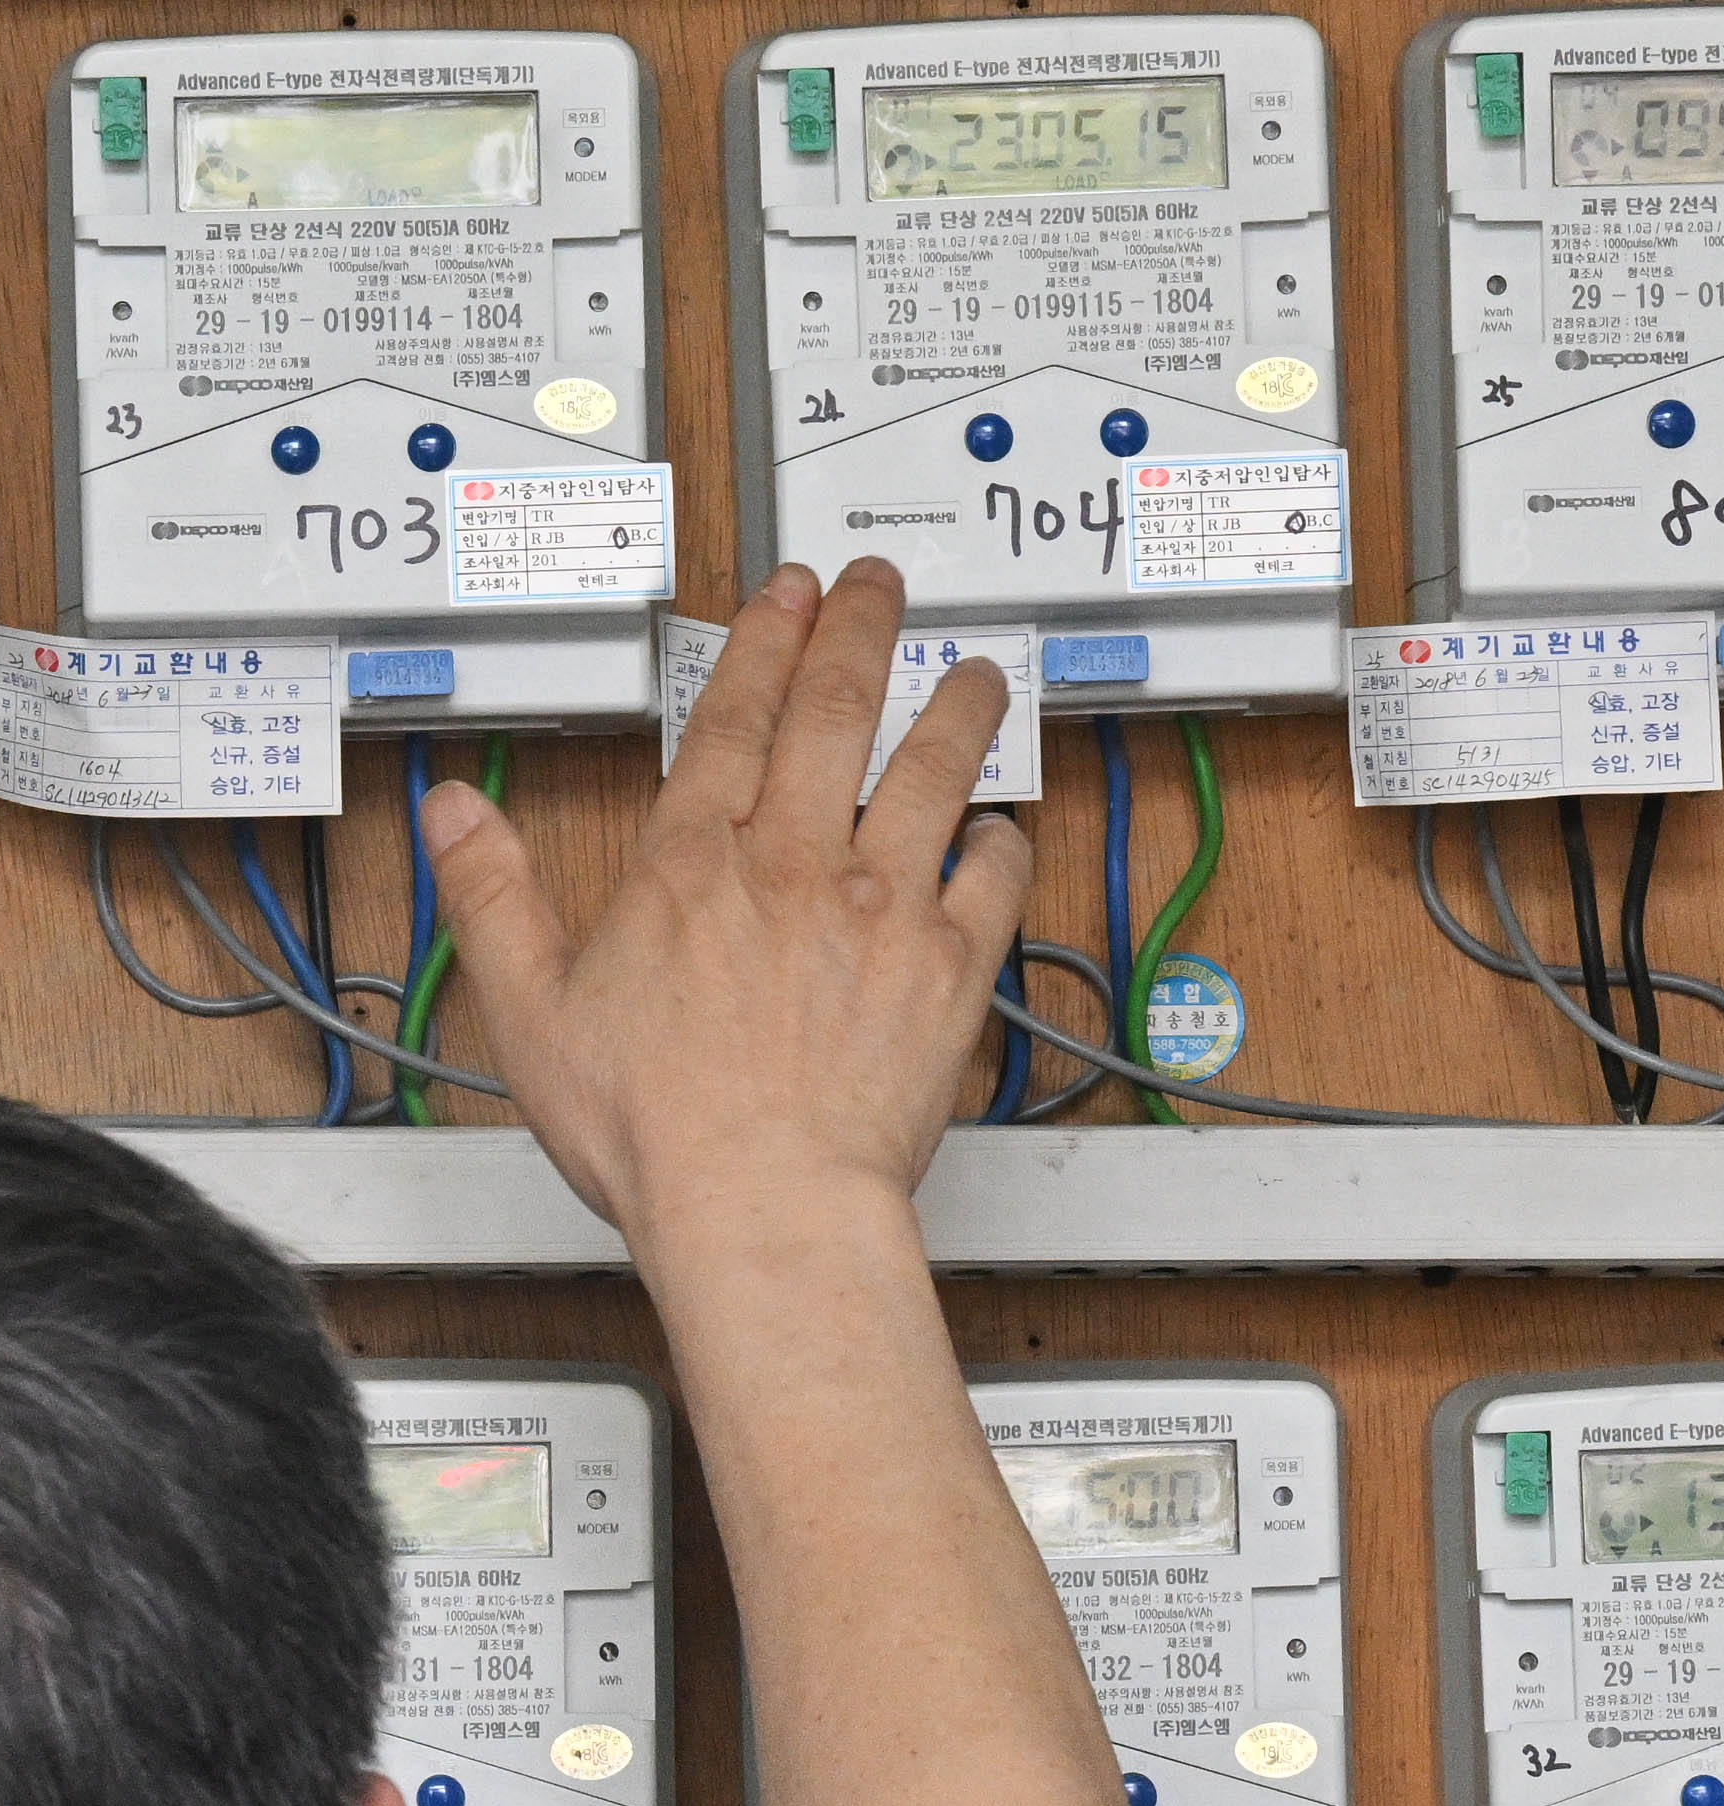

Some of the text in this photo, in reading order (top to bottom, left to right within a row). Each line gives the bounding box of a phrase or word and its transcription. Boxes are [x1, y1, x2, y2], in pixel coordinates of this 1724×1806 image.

[1553, 47, 1637, 65] Advanced
[1642, 46, 1697, 65] E-type
[895, 212, 932, 232] 교류
[940, 210, 977, 230] 단상
[984, 208, 1032, 228] 2선식
[1040, 207, 1085, 225] 220V
[1155, 202, 1198, 220] 60Hz
[323, 303, 523, 333] 0199114 1804
[1014, 291, 1122, 320] 0199115
[462, 509, 554, 526] 변압기명 TR
[986, 478, 1124, 575] 704
[296, 497, 441, 573] 703
[463, 554, 520, 571] 조사일자
[464, 576, 520, 592] 조사회사
[473, 1655, 533, 1681] 1804
[1162, 1652, 1222, 1679] 1804
[1603, 1661, 1633, 1687] 29
[1668, 1658, 1697, 1685] 19
